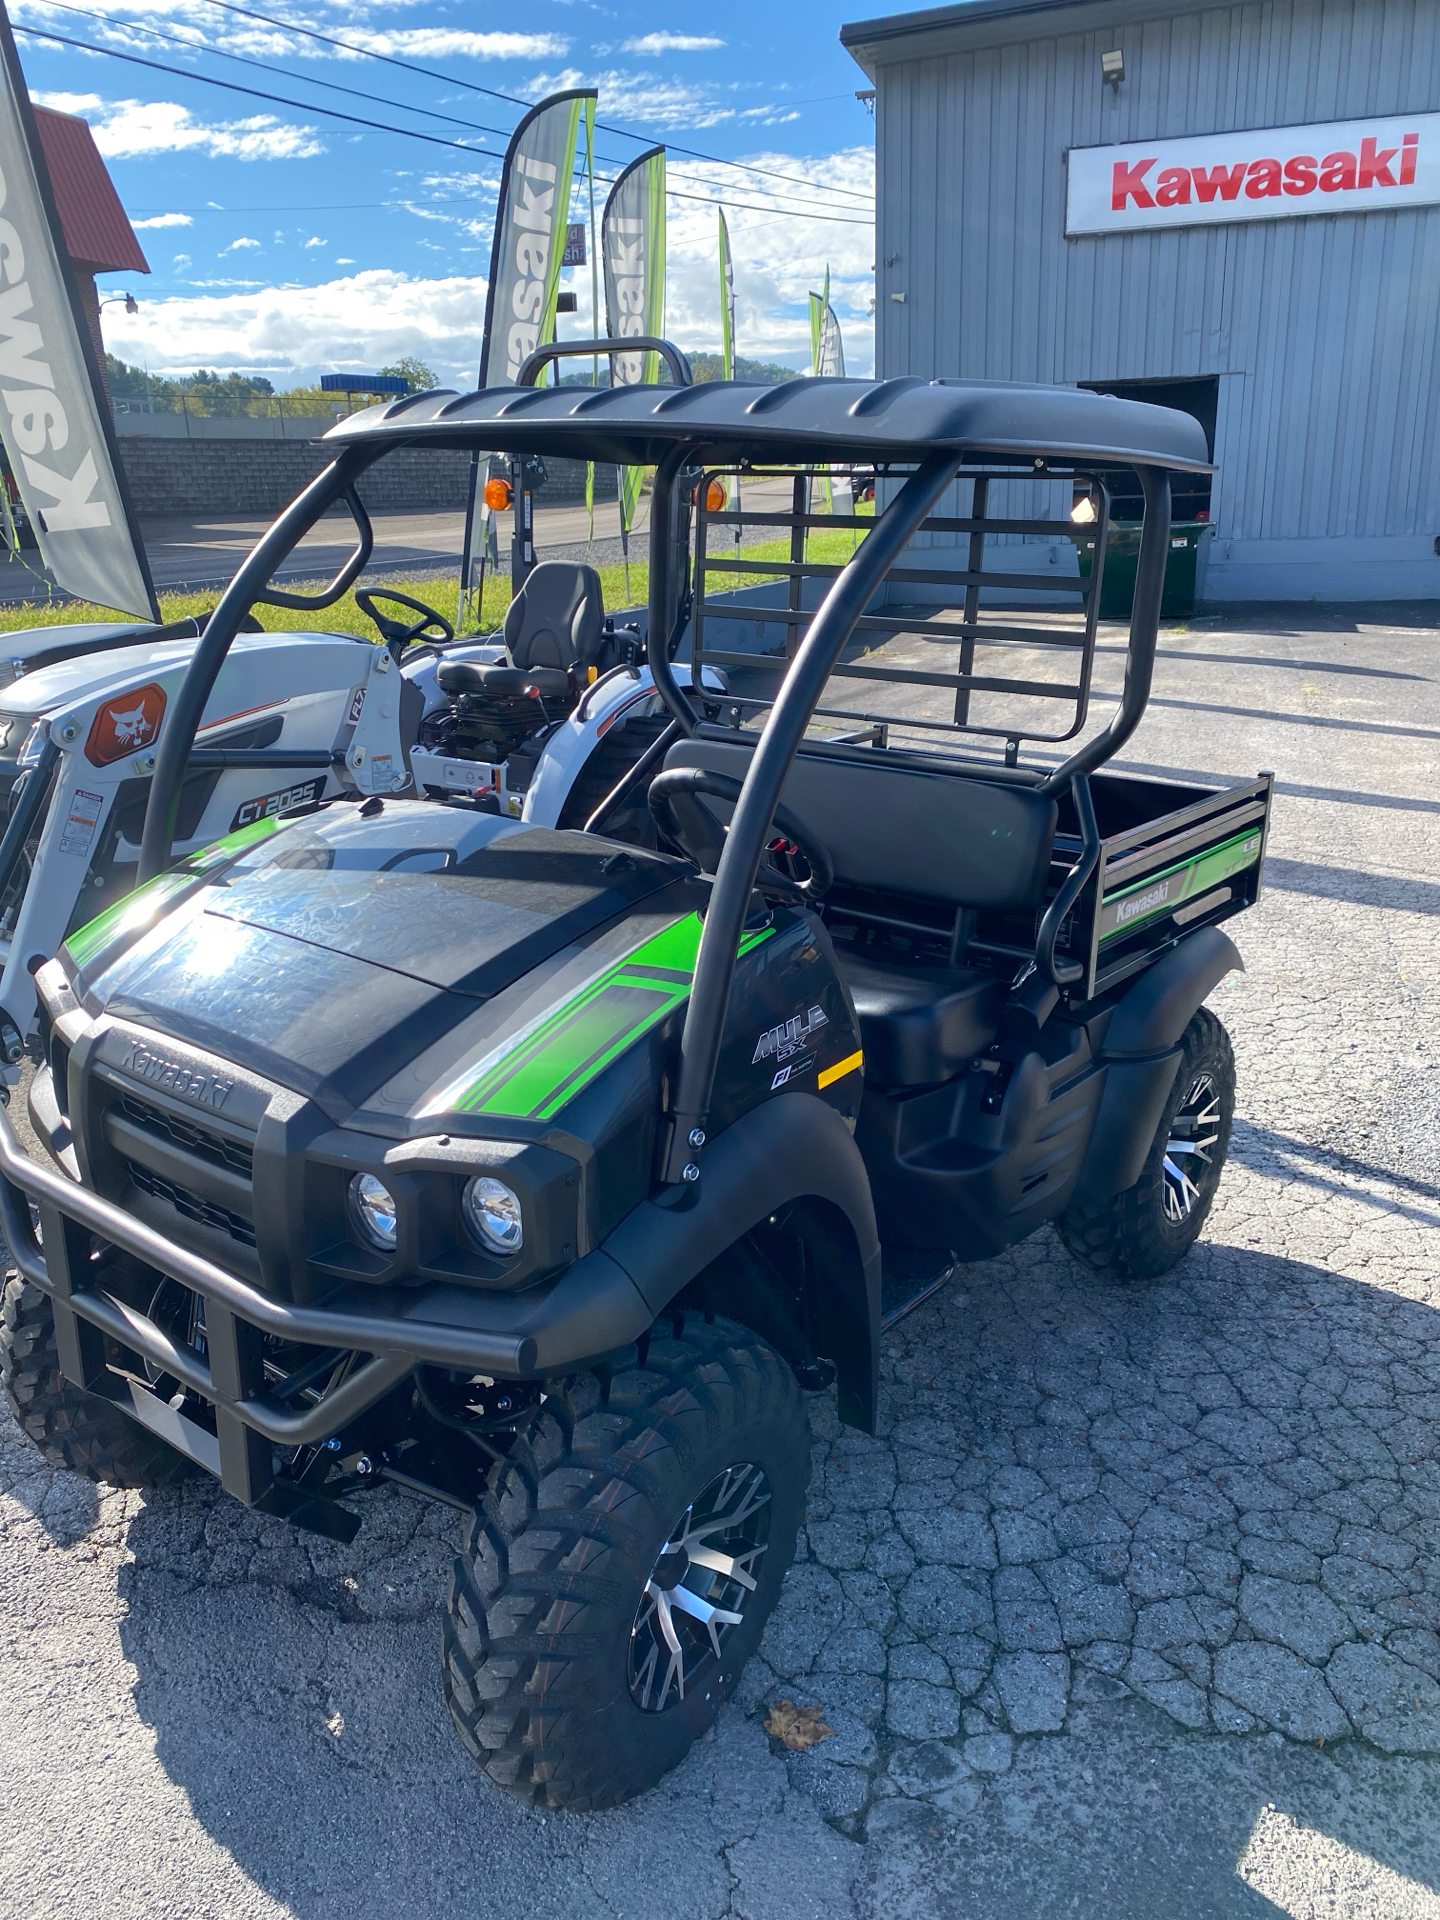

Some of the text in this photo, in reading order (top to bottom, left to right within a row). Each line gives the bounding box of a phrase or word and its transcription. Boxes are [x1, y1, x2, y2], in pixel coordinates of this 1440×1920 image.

[1111, 133, 1419, 211] Kawasaki
[506, 153, 557, 382] asaki
[608, 217, 645, 387] asaki
[238, 782, 315, 824] CT2025
[1243, 837, 1258, 854] LE
[1116, 882, 1169, 923] Kawasaki
[752, 1004, 830, 1064] MULE
[777, 1035, 808, 1062] SX
[120, 1040, 234, 1110] Kawasaki
